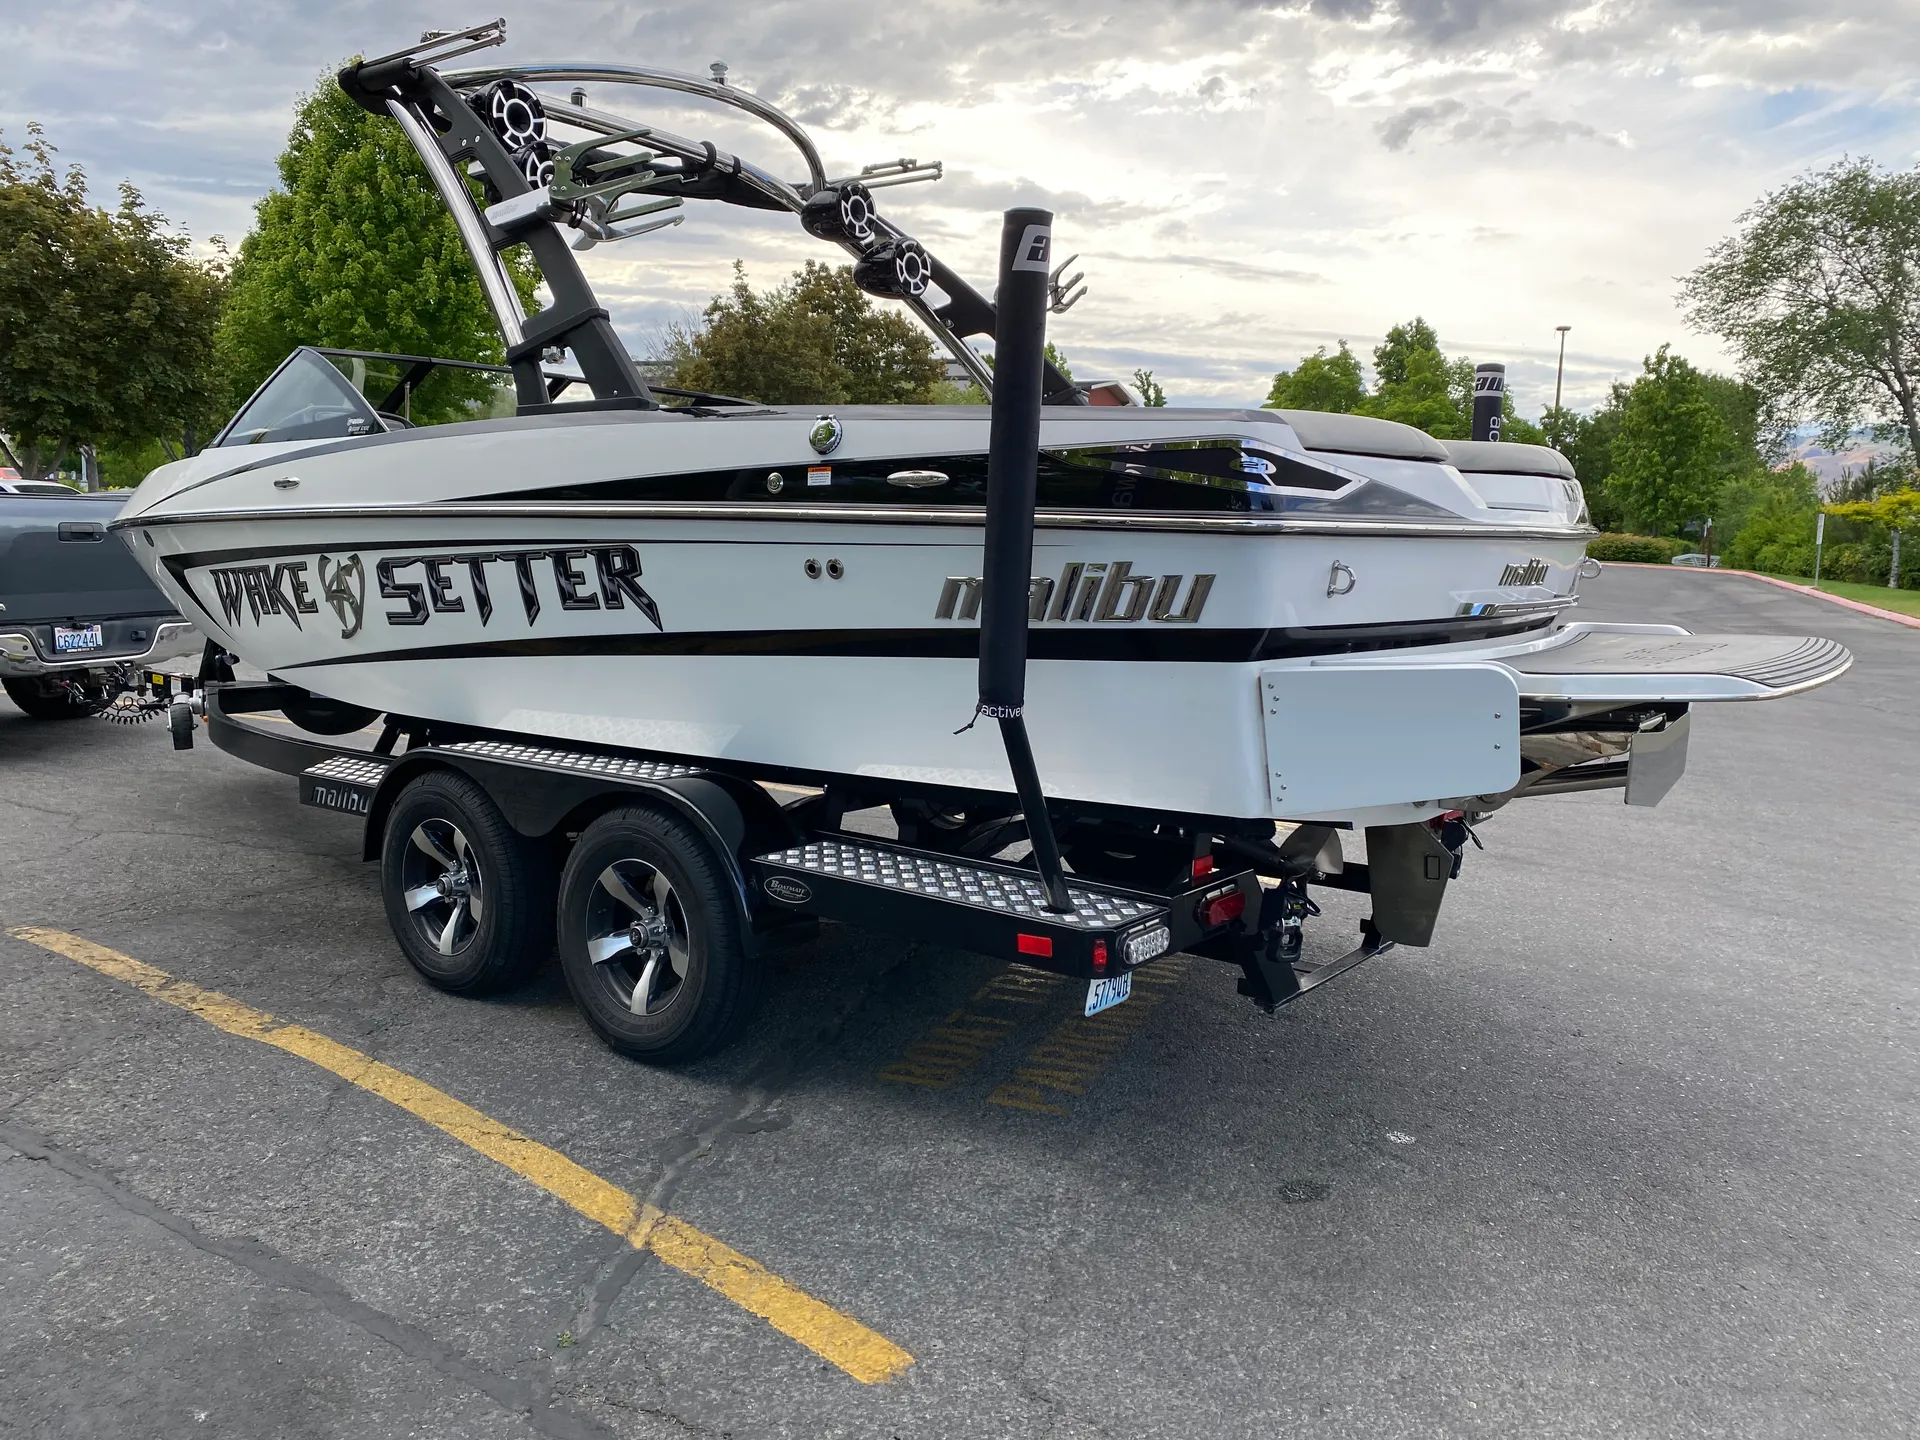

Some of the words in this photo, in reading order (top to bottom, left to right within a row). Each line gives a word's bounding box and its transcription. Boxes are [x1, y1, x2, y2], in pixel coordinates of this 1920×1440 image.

[209, 560, 319, 632] WAKE
[376, 544, 664, 632] SETTER
[57, 632, 102, 649] C62244L
[980, 704, 1023, 718] active
[313, 784, 371, 813] malibu
